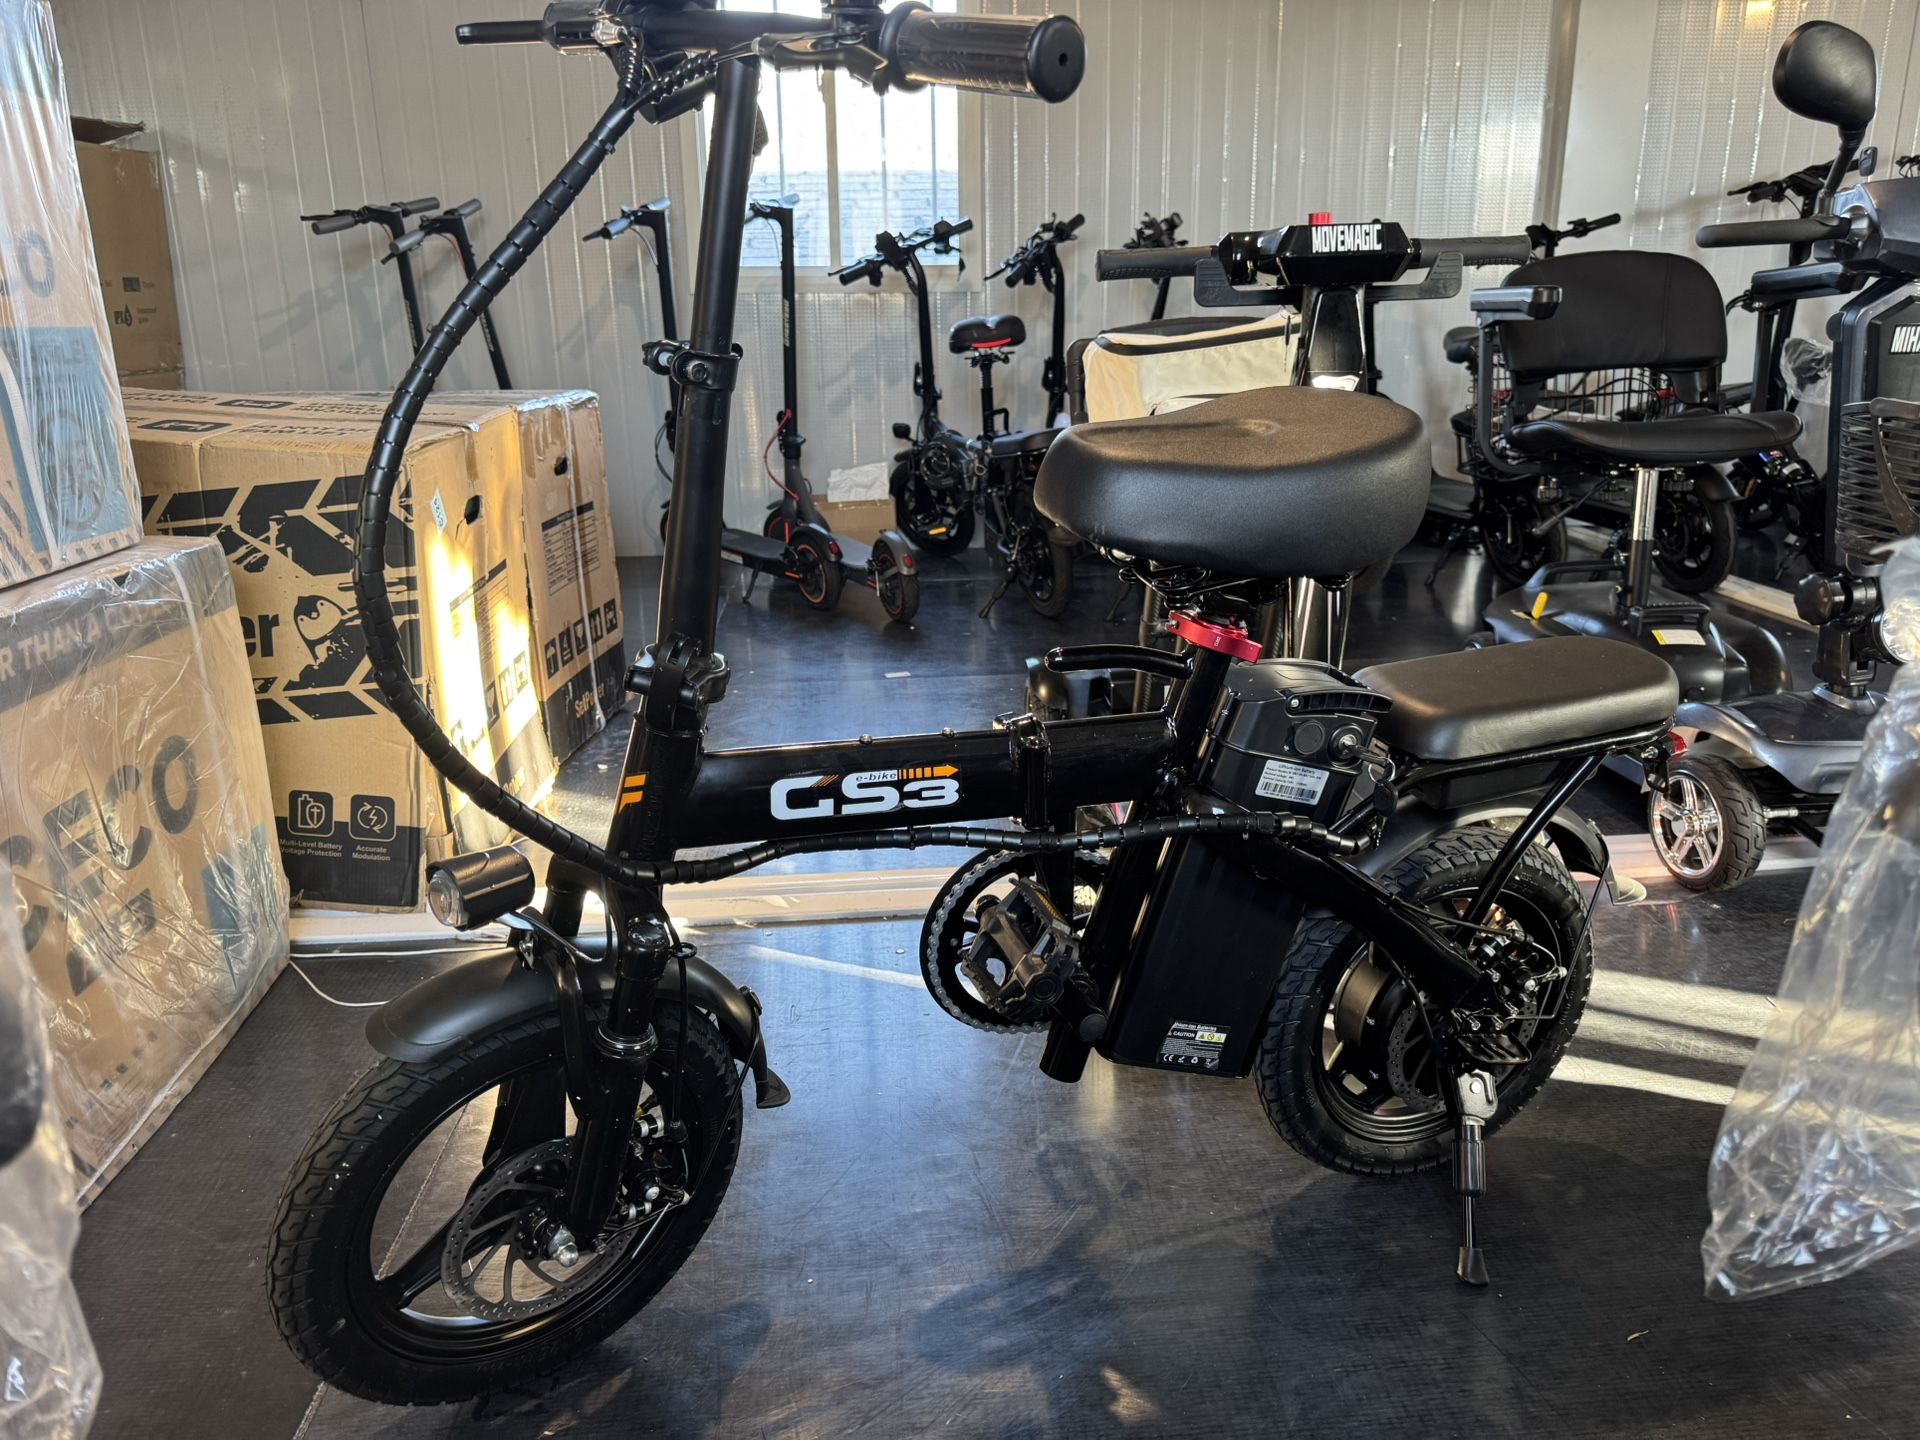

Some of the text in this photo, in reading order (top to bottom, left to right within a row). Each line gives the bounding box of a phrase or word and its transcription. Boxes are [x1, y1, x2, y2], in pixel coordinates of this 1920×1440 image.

[1311, 223, 1382, 254] MOVEMAGIC
[17, 617, 84, 671] THAN
[855, 772, 897, 782] e-bike
[770, 770, 960, 821] GS3
[280, 839, 343, 851] Multi-Level Battery
[355, 845, 387, 854] Accurate
[307, 848, 342, 858] Protection
[351, 852, 391, 861] Modulation
